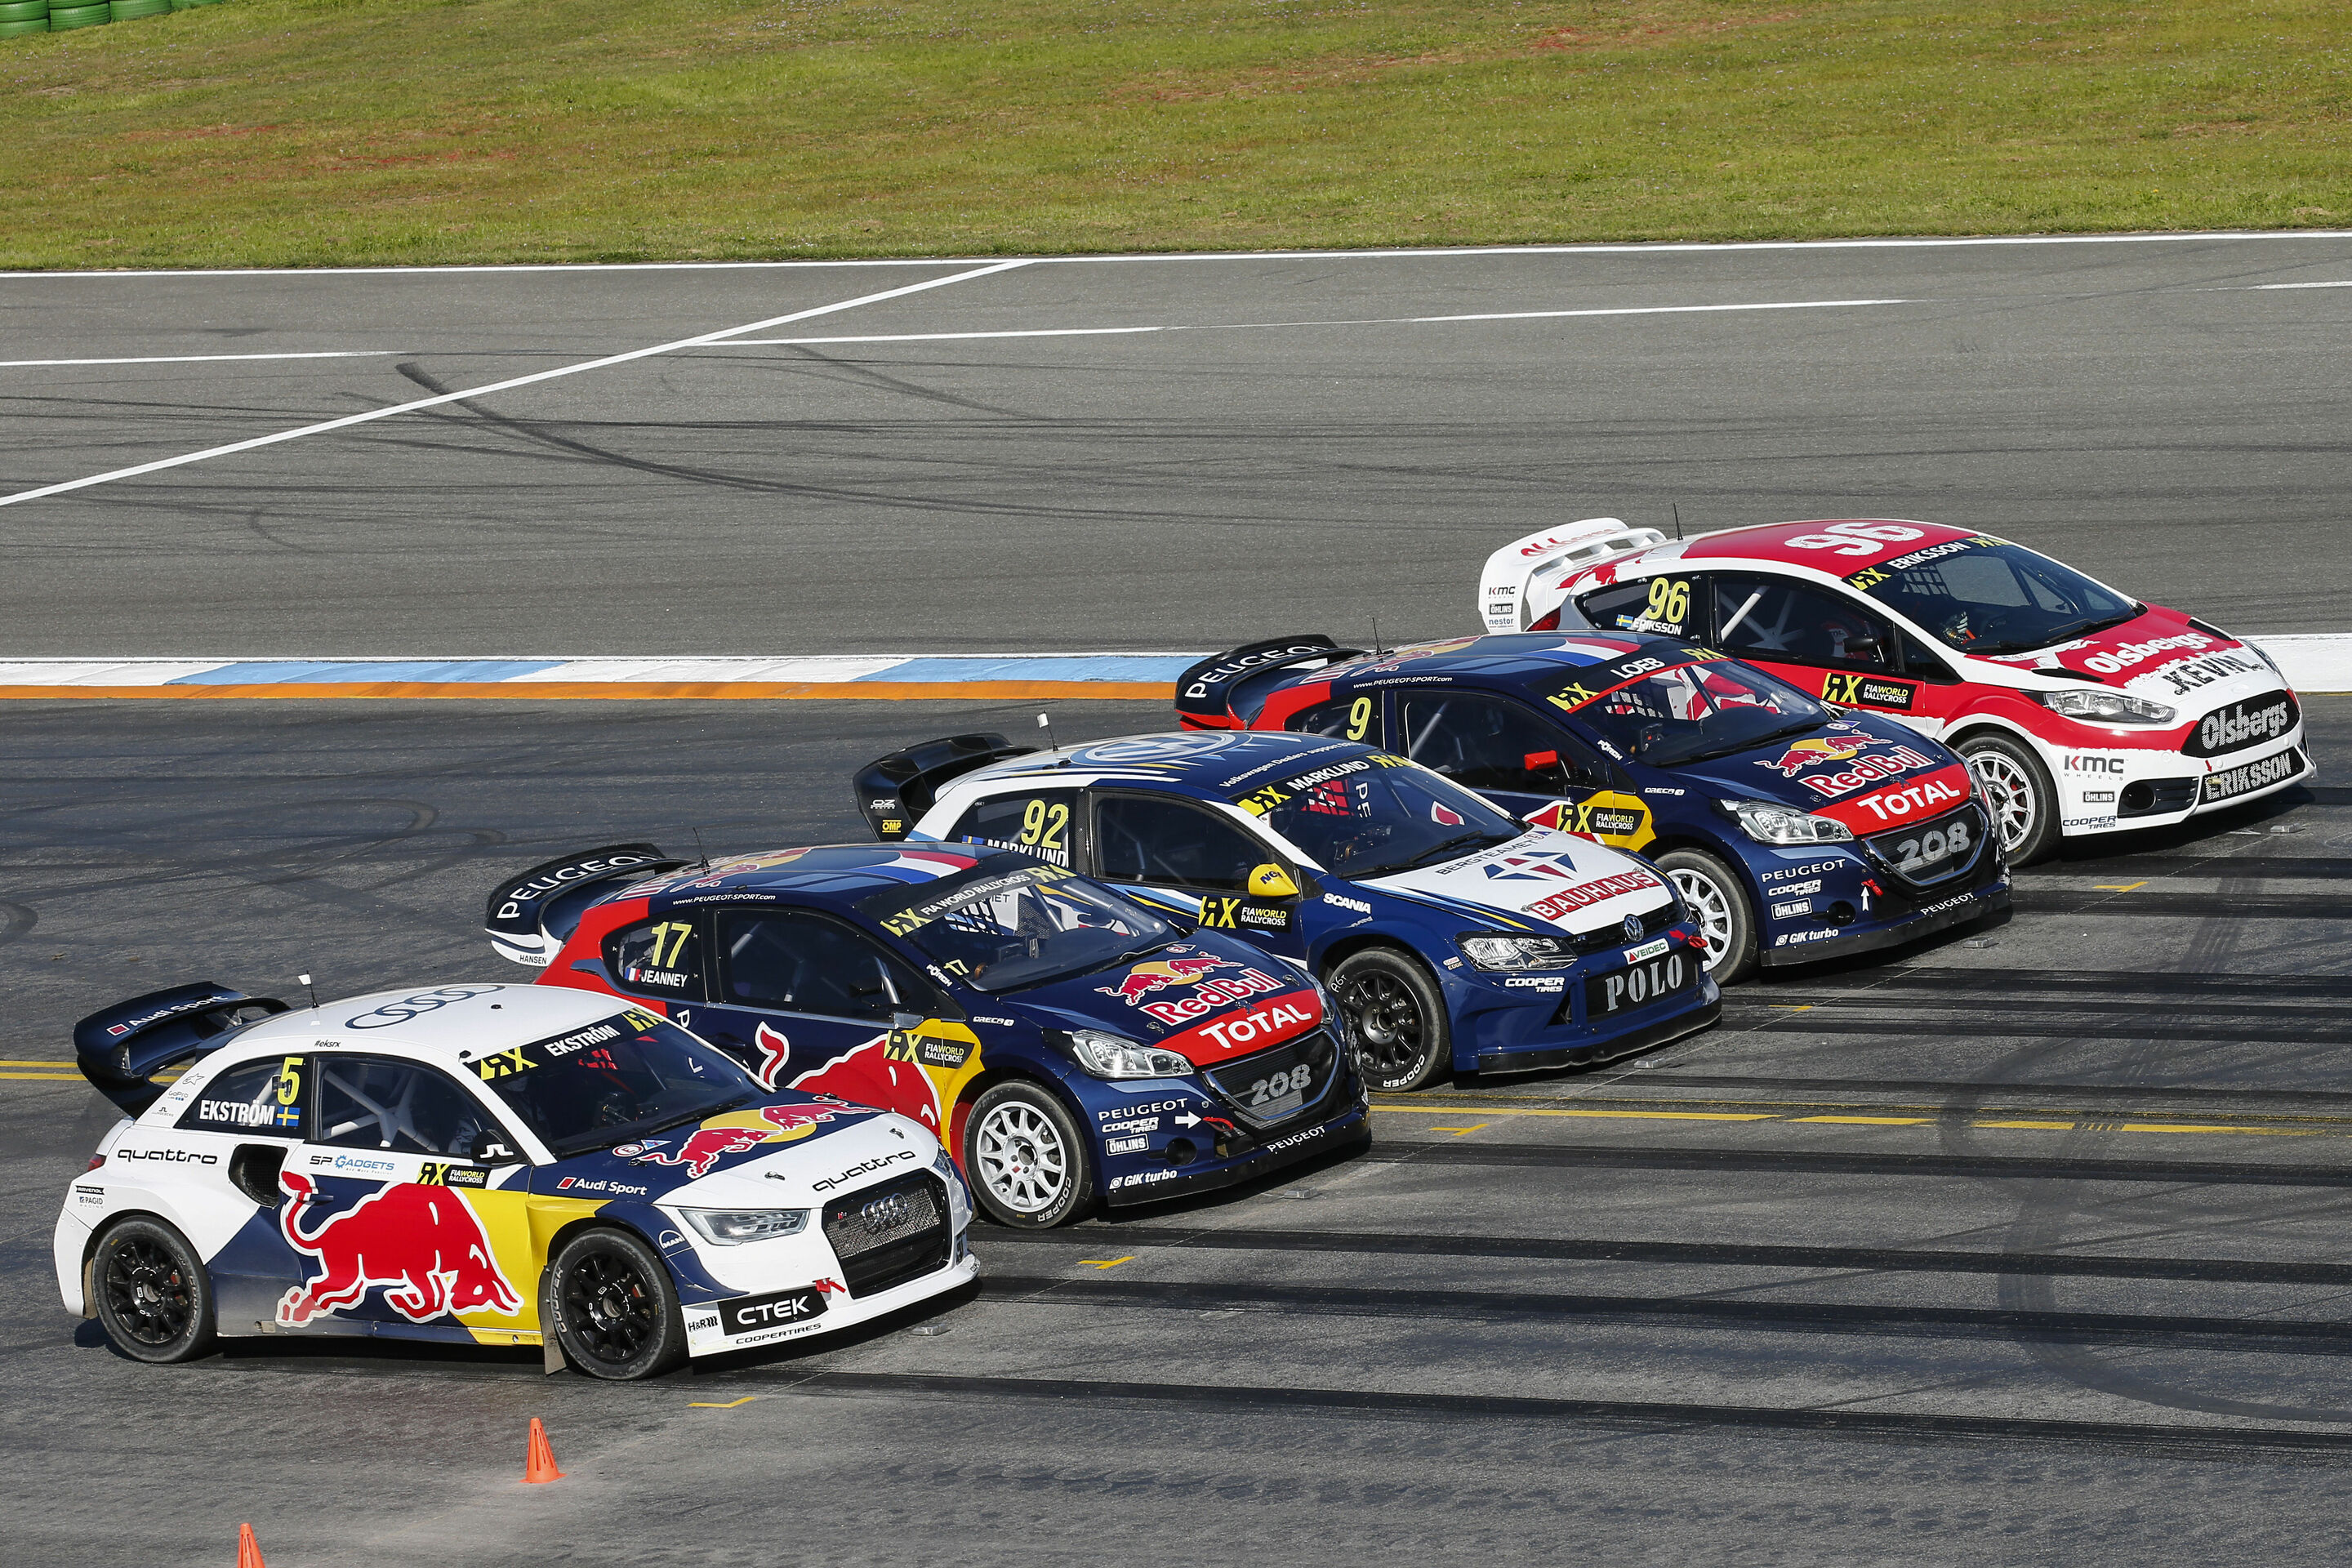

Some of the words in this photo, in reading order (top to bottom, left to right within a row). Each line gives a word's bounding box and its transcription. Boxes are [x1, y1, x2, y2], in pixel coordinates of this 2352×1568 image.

[1784, 522, 1925, 556] 96
[1886, 541, 1971, 570] ERIKSSON
[1851, 568, 1891, 590] RX
[1646, 577, 1690, 623] 96
[1633, 618, 1682, 635] ERIKSSON
[2083, 632, 2214, 674] Olsbergs
[1610, 657, 1666, 679] LOEB
[2163, 656, 2252, 689] KEVIN
[1822, 672, 1864, 704] RX
[1864, 692, 1907, 704] RALLYCROSS
[1346, 697, 1371, 741] 9
[2202, 700, 2288, 750] Olsbergs
[1286, 760, 1370, 791] MARKLUND
[2064, 773, 2123, 781] WHEELS
[2205, 753, 2292, 800] ERIKSSON
[1236, 786, 1292, 816] RX
[1856, 780, 1961, 821] TOTAL
[2084, 791, 2114, 802] ÖHLINS
[882, 821, 902, 831] OMP
[1020, 800, 1069, 849] 92
[1556, 804, 1593, 833] RX
[1596, 820, 1633, 831] RALLYCROSS
[2062, 816, 2117, 827] COOPER
[1436, 838, 1539, 875] BERGTEAMET
[1896, 822, 1971, 871] 208
[1761, 859, 1846, 883] PEUGEOT
[673, 893, 776, 906] www.PEUGEOT-SPORT.com
[920, 903, 939, 915] FIA
[939, 889, 976, 908] WORLD
[974, 874, 1031, 894] RALLYCROSS
[1535, 873, 1655, 917] BAUHAUS
[1768, 879, 1822, 897] COOPER
[1795, 886, 1821, 897] TIRES
[1198, 896, 1241, 929] RX
[1323, 893, 1371, 914] SCANIA
[1775, 901, 1809, 917] ÖHLINS
[1919, 892, 1975, 915] PEUGEOT
[880, 907, 933, 938] RX
[1241, 915, 1285, 926] RALLYCROSS
[651, 921, 693, 969] 17
[1807, 928, 1839, 941] turbo
[519, 954, 547, 964] HANSEN
[1634, 942, 1666, 959] VEIDEC
[641, 969, 688, 987] JEANNEY
[943, 959, 969, 976] 17
[1505, 977, 1565, 987] COOPER
[1605, 954, 1683, 1012] POLO
[128, 1009, 170, 1027] Audi
[973, 1016, 1004, 1024] ORECA
[1198, 1003, 1312, 1049] TOTAL
[314, 1039, 341, 1048] #eksrx
[544, 1024, 621, 1057] EKSTRÖM
[883, 1030, 924, 1063] RX
[480, 1047, 539, 1080] RX
[924, 1051, 963, 1063] RALLYCROSS
[278, 1056, 304, 1106] 5
[1383, 1054, 1425, 1088] COOPER
[1250, 1063, 1311, 1107] 208
[199, 1099, 275, 1125] EKSTRÖM
[1098, 1098, 1188, 1121] PEUGEOT
[1102, 1116, 1160, 1134] COOPER
[1129, 1124, 1158, 1134] TIRES
[1109, 1138, 1145, 1154] ÖHLINS
[1266, 1125, 1326, 1154] PEUGEOT
[118, 1148, 218, 1165] quattro
[310, 1156, 333, 1166] SP
[335, 1154, 394, 1171] GADGETS
[416, 1162, 451, 1187] RX
[448, 1176, 483, 1184] RALLYCROSS
[812, 1151, 916, 1192] quattro
[1144, 1169, 1178, 1183] turbo
[575, 1178, 608, 1191] Audi
[608, 1182, 648, 1196] Sport
[85, 1196, 104, 1205] PAGID
[1037, 1176, 1071, 1223] COOPER
[663, 1237, 686, 1249] MAN
[737, 1295, 810, 1325] CTEK
[688, 1319, 706, 1332] H&R
